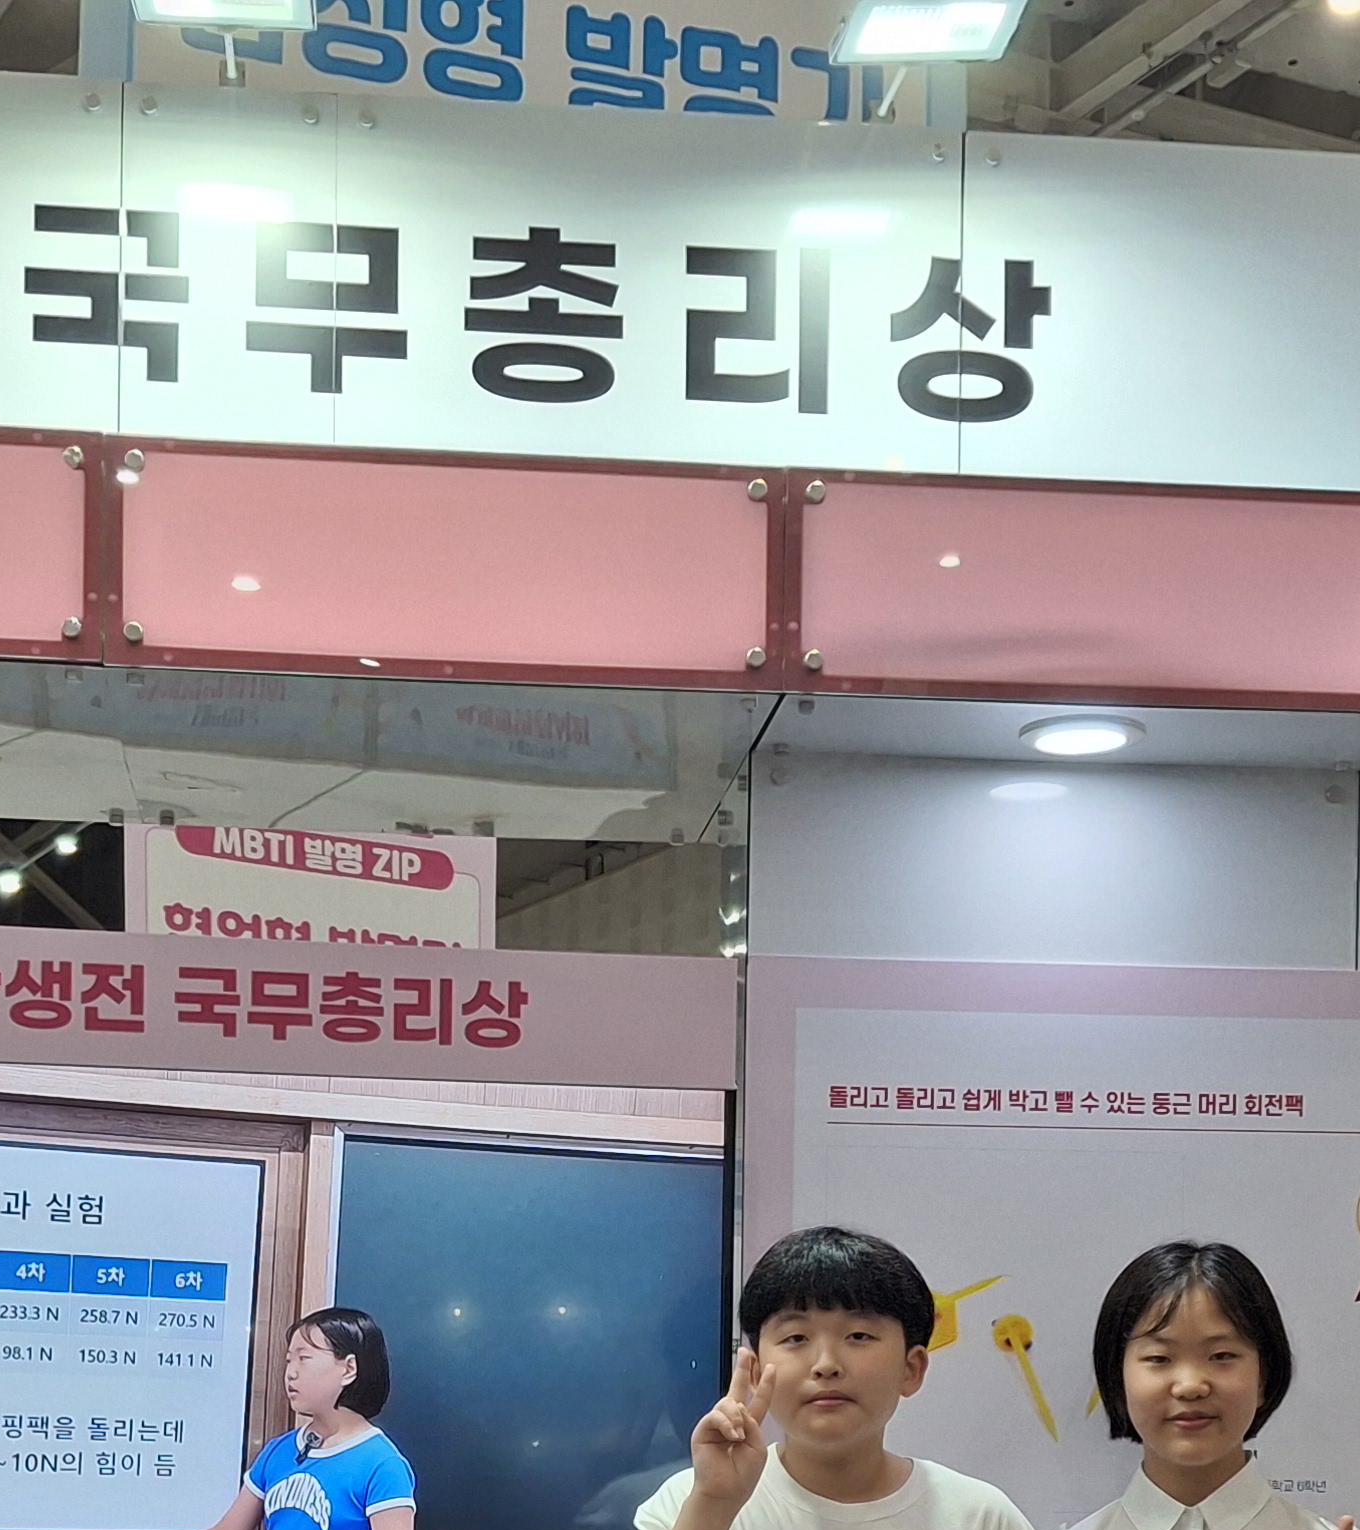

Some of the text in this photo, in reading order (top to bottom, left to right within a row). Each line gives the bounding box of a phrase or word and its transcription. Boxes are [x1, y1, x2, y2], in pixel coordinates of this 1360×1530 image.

[24, 203, 1051, 422] 국무총리상
[213, 826, 422, 881] MBTI 발명 ZIP
[174, 966, 529, 1048] 국무총리상
[895, 1087, 956, 1111] 돌리고
[962, 1088, 1001, 1113] 쉽게
[1008, 1089, 1049, 1113] 박고
[1079, 1091, 1100, 1114] 수
[1106, 1091, 1145, 1115] 있는
[1151, 1092, 1191, 1116] 둥근
[1198, 1093, 1237, 1117] 머리
[1243, 1093, 1304, 1118] 회전팩
[45, 1192, 105, 1227] 실험
[15, 1261, 46, 1283] 4차
[96, 1266, 126, 1287] 5차
[174, 1270, 204, 1291] 6차
[46, 1307, 60, 1322] N
[79, 1309, 122, 1325] 258.7
[125, 1311, 139, 1326] N
[158, 1313, 199, 1329] 270.5
[202, 1315, 216, 1330] N
[2, 1346, 35, 1362] 98.1
[39, 1347, 53, 1362] N
[79, 1349, 119, 1365] 150.3
[123, 1351, 136, 1366] N
[200, 1353, 213, 1369] N
[87, 1416, 184, 1444] 돌리는데
[95, 1451, 142, 1477] 힘이
[152, 1454, 177, 1478] 듬
